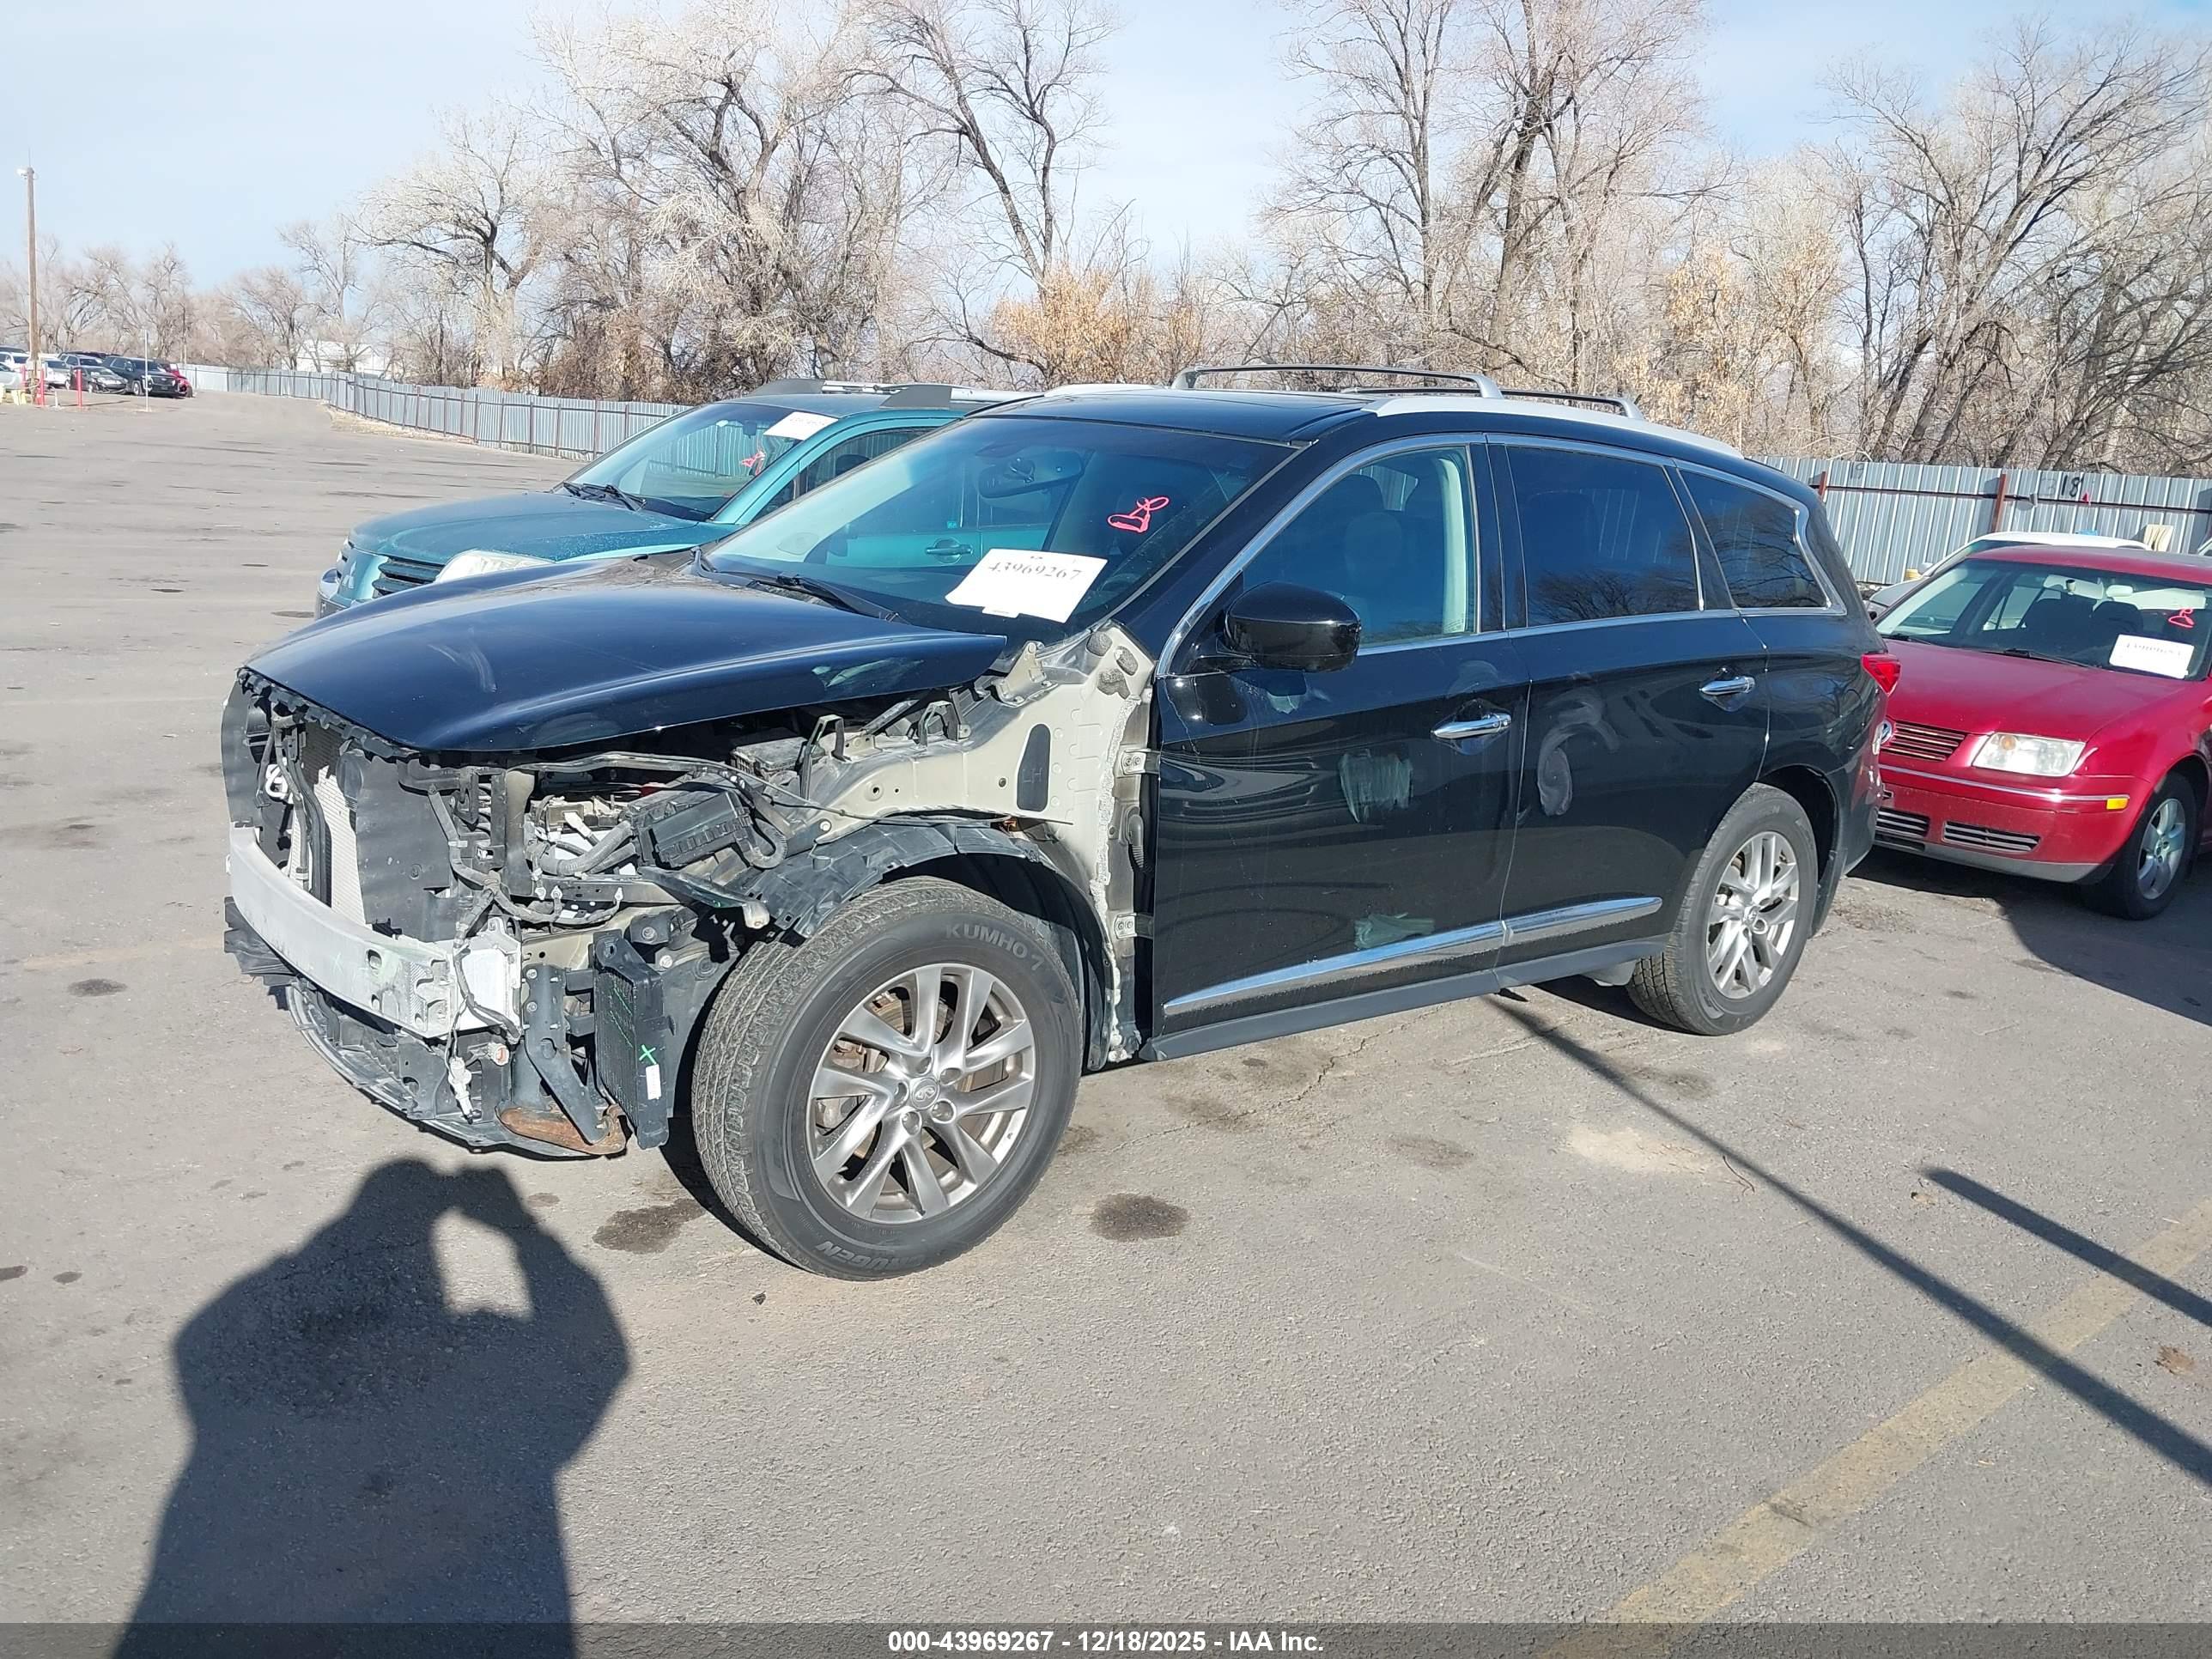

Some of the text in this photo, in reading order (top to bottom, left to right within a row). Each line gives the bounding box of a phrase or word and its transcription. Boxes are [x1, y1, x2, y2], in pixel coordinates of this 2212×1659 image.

[2062, 474, 2083, 498] 18
[988, 562, 1082, 580] 43969267
[945, 922, 1029, 959] KUMHO
